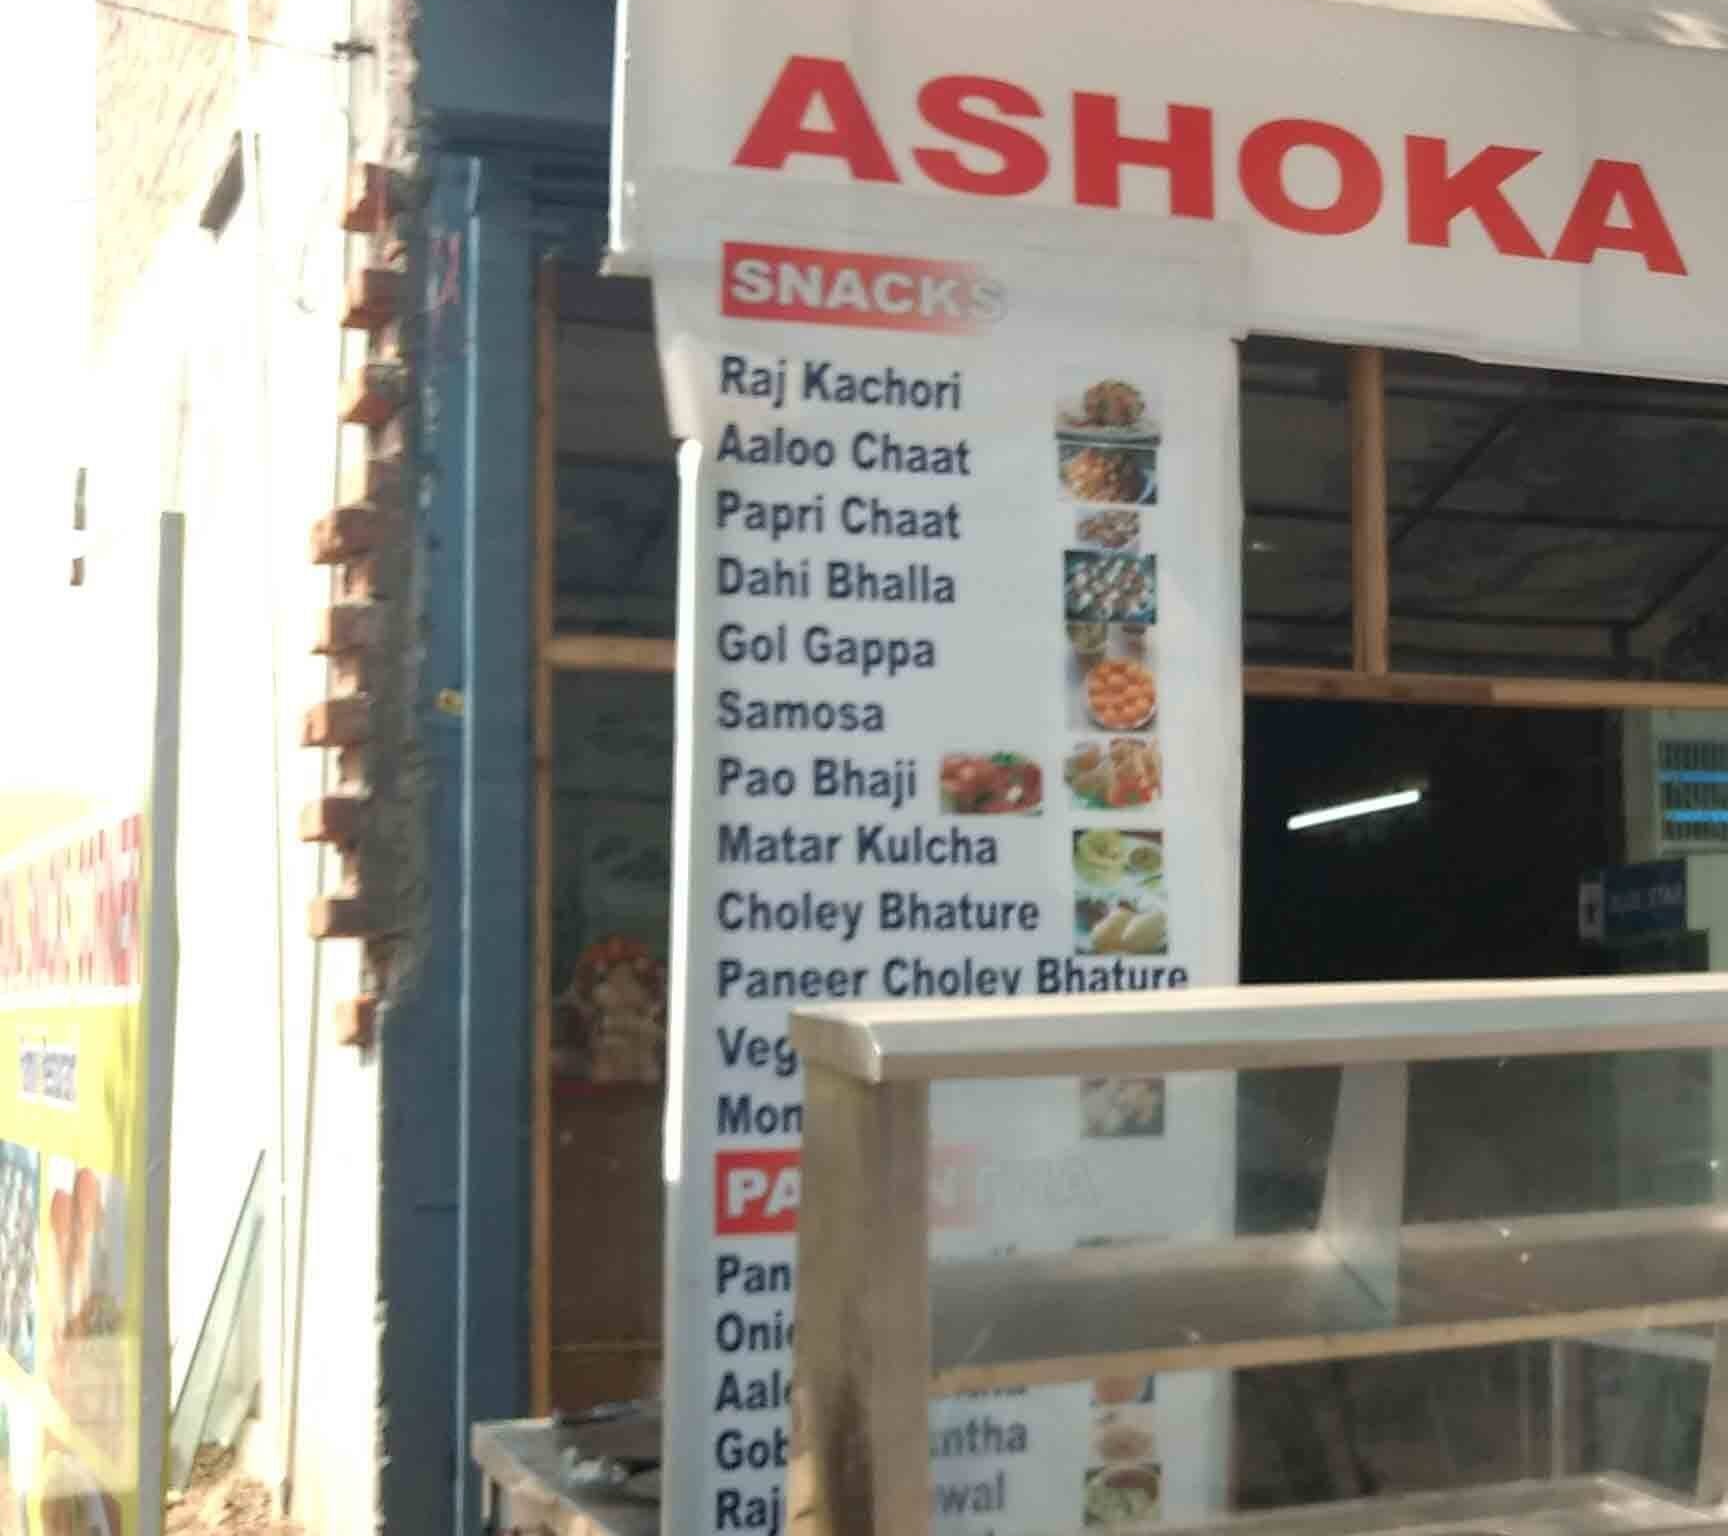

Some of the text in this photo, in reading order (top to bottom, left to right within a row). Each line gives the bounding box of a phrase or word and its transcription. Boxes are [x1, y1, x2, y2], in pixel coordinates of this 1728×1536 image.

[732, 55, 1688, 276] ASHOKA
[731, 260, 1008, 325] SNACKS
[719, 355, 962, 410] Raj Kachori
[716, 425, 971, 477] Aaloo Chaat
[716, 490, 961, 540] Papri Chaat
[716, 557, 956, 604] Dahi Bhalla
[716, 624, 936, 677] Gol Gappa
[716, 690, 886, 733] Samosa
[716, 757, 917, 808] Pao Bhaji
[717, 825, 998, 866] Matar Kulcha
[716, 892, 1040, 941] Choley Bhature
[716, 957, 1189, 998] Paneer Choley Bhature
